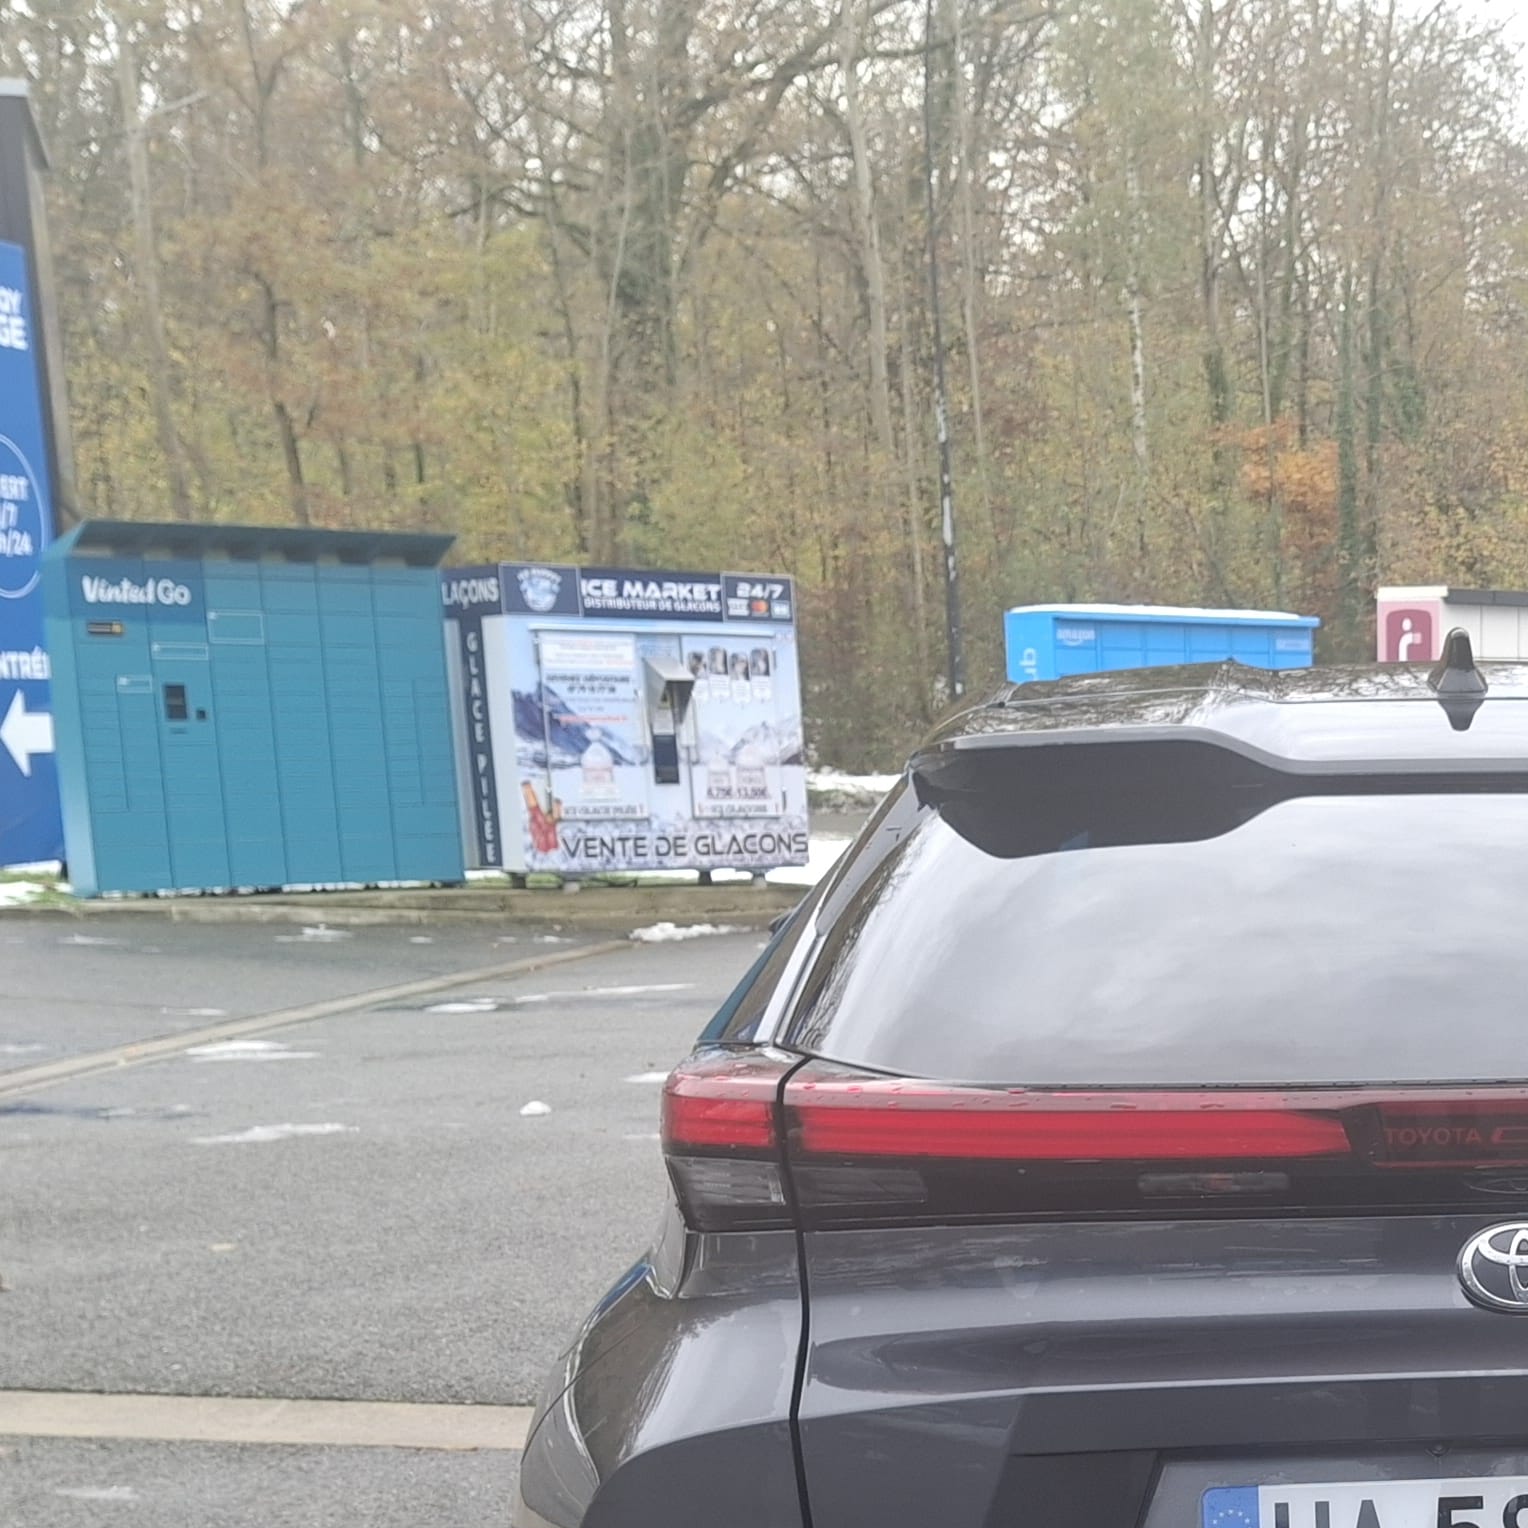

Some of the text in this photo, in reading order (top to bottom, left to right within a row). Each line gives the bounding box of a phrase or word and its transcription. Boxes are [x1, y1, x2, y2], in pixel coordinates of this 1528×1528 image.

[82, 575, 192, 605] Vinted Go
[441, 577, 499, 609] LAÇONS
[581, 578, 721, 600] ICE MARKET
[736, 582, 784, 599] 24/7
[584, 598, 656, 611] DISTRIBUTEUR
[659, 601, 673, 611] DE
[562, 836, 648, 859] VENTE
[655, 836, 688, 857] DE
[1385, 1127, 1481, 1145] TOYOTA
